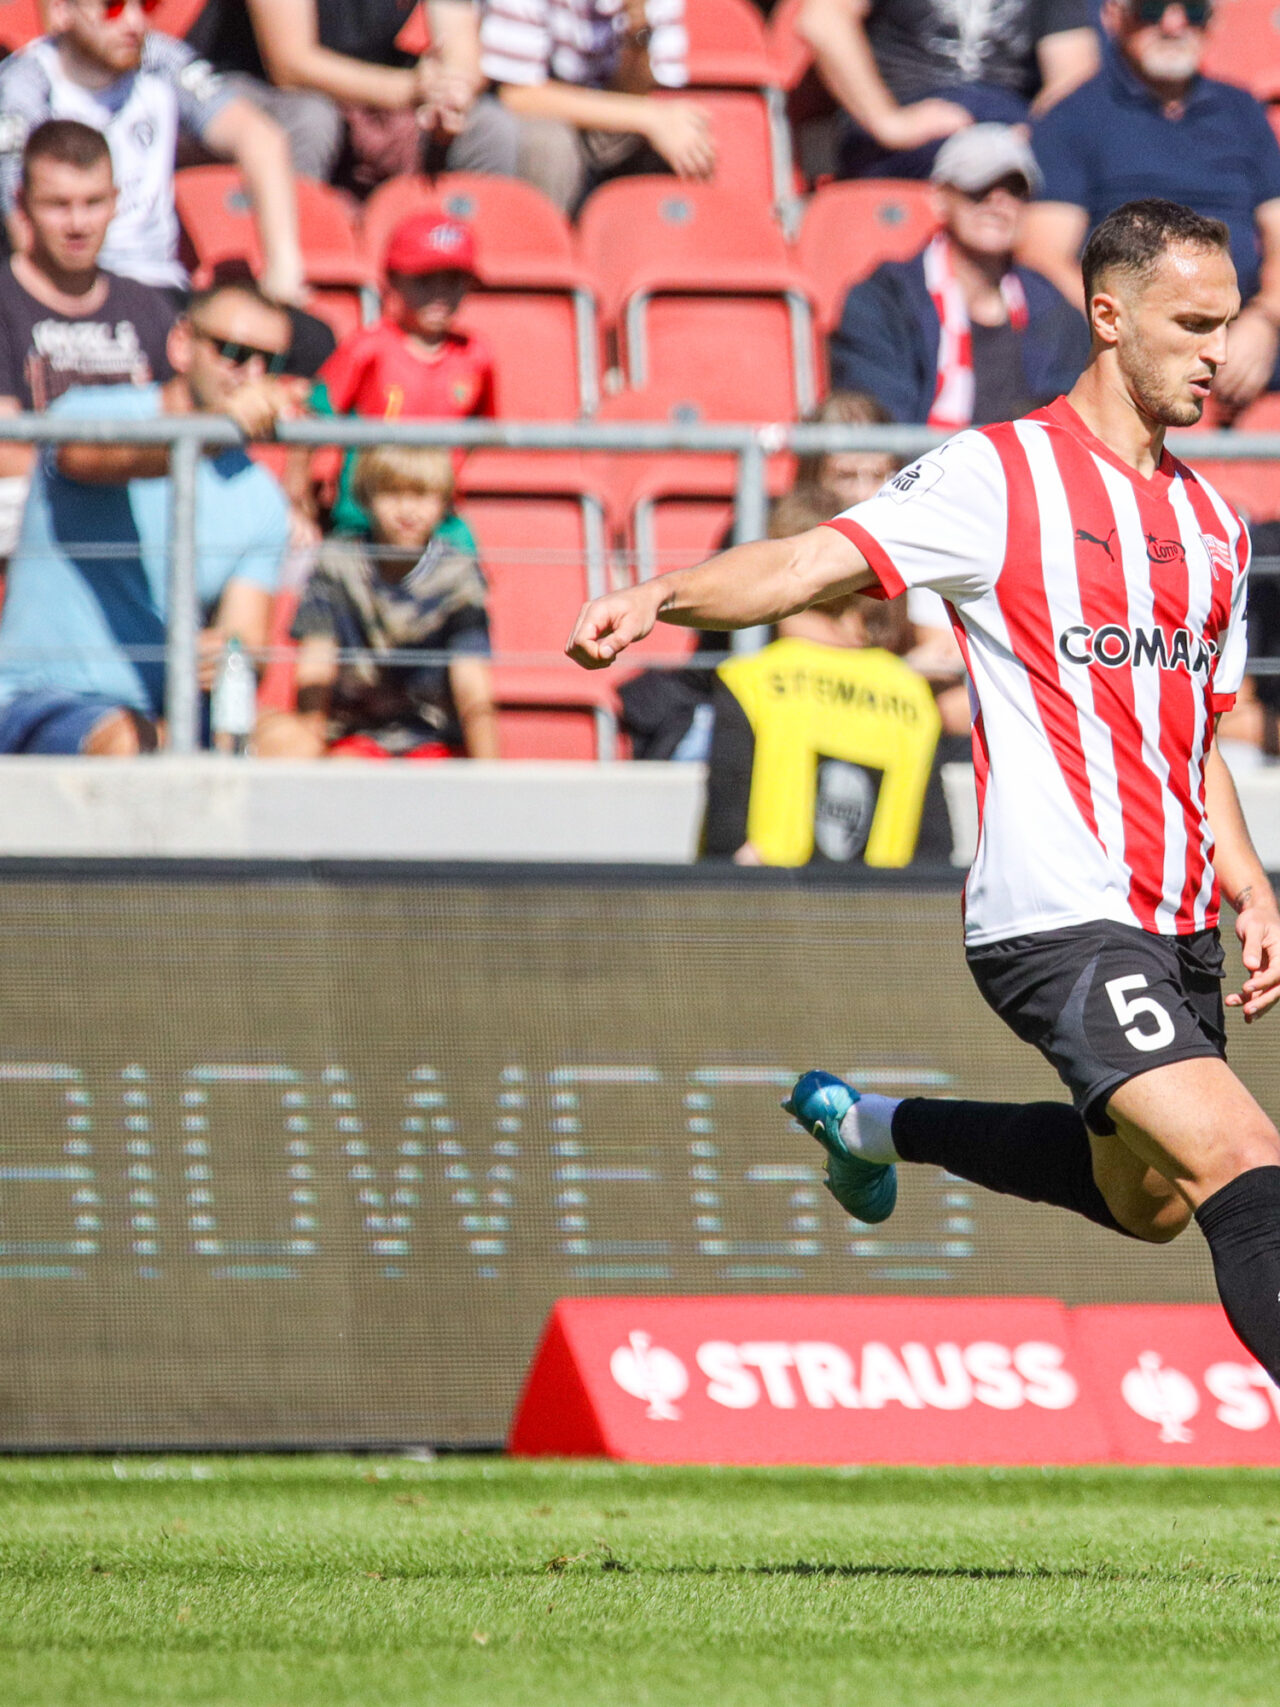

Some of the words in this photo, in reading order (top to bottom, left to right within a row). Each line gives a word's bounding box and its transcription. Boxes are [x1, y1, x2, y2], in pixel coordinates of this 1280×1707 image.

[1153, 545, 1179, 558] LOTTO
[769, 671, 919, 724] STEWARD
[1105, 973, 1176, 1052] 5
[697, 1342, 1077, 1411] STRAUSS
